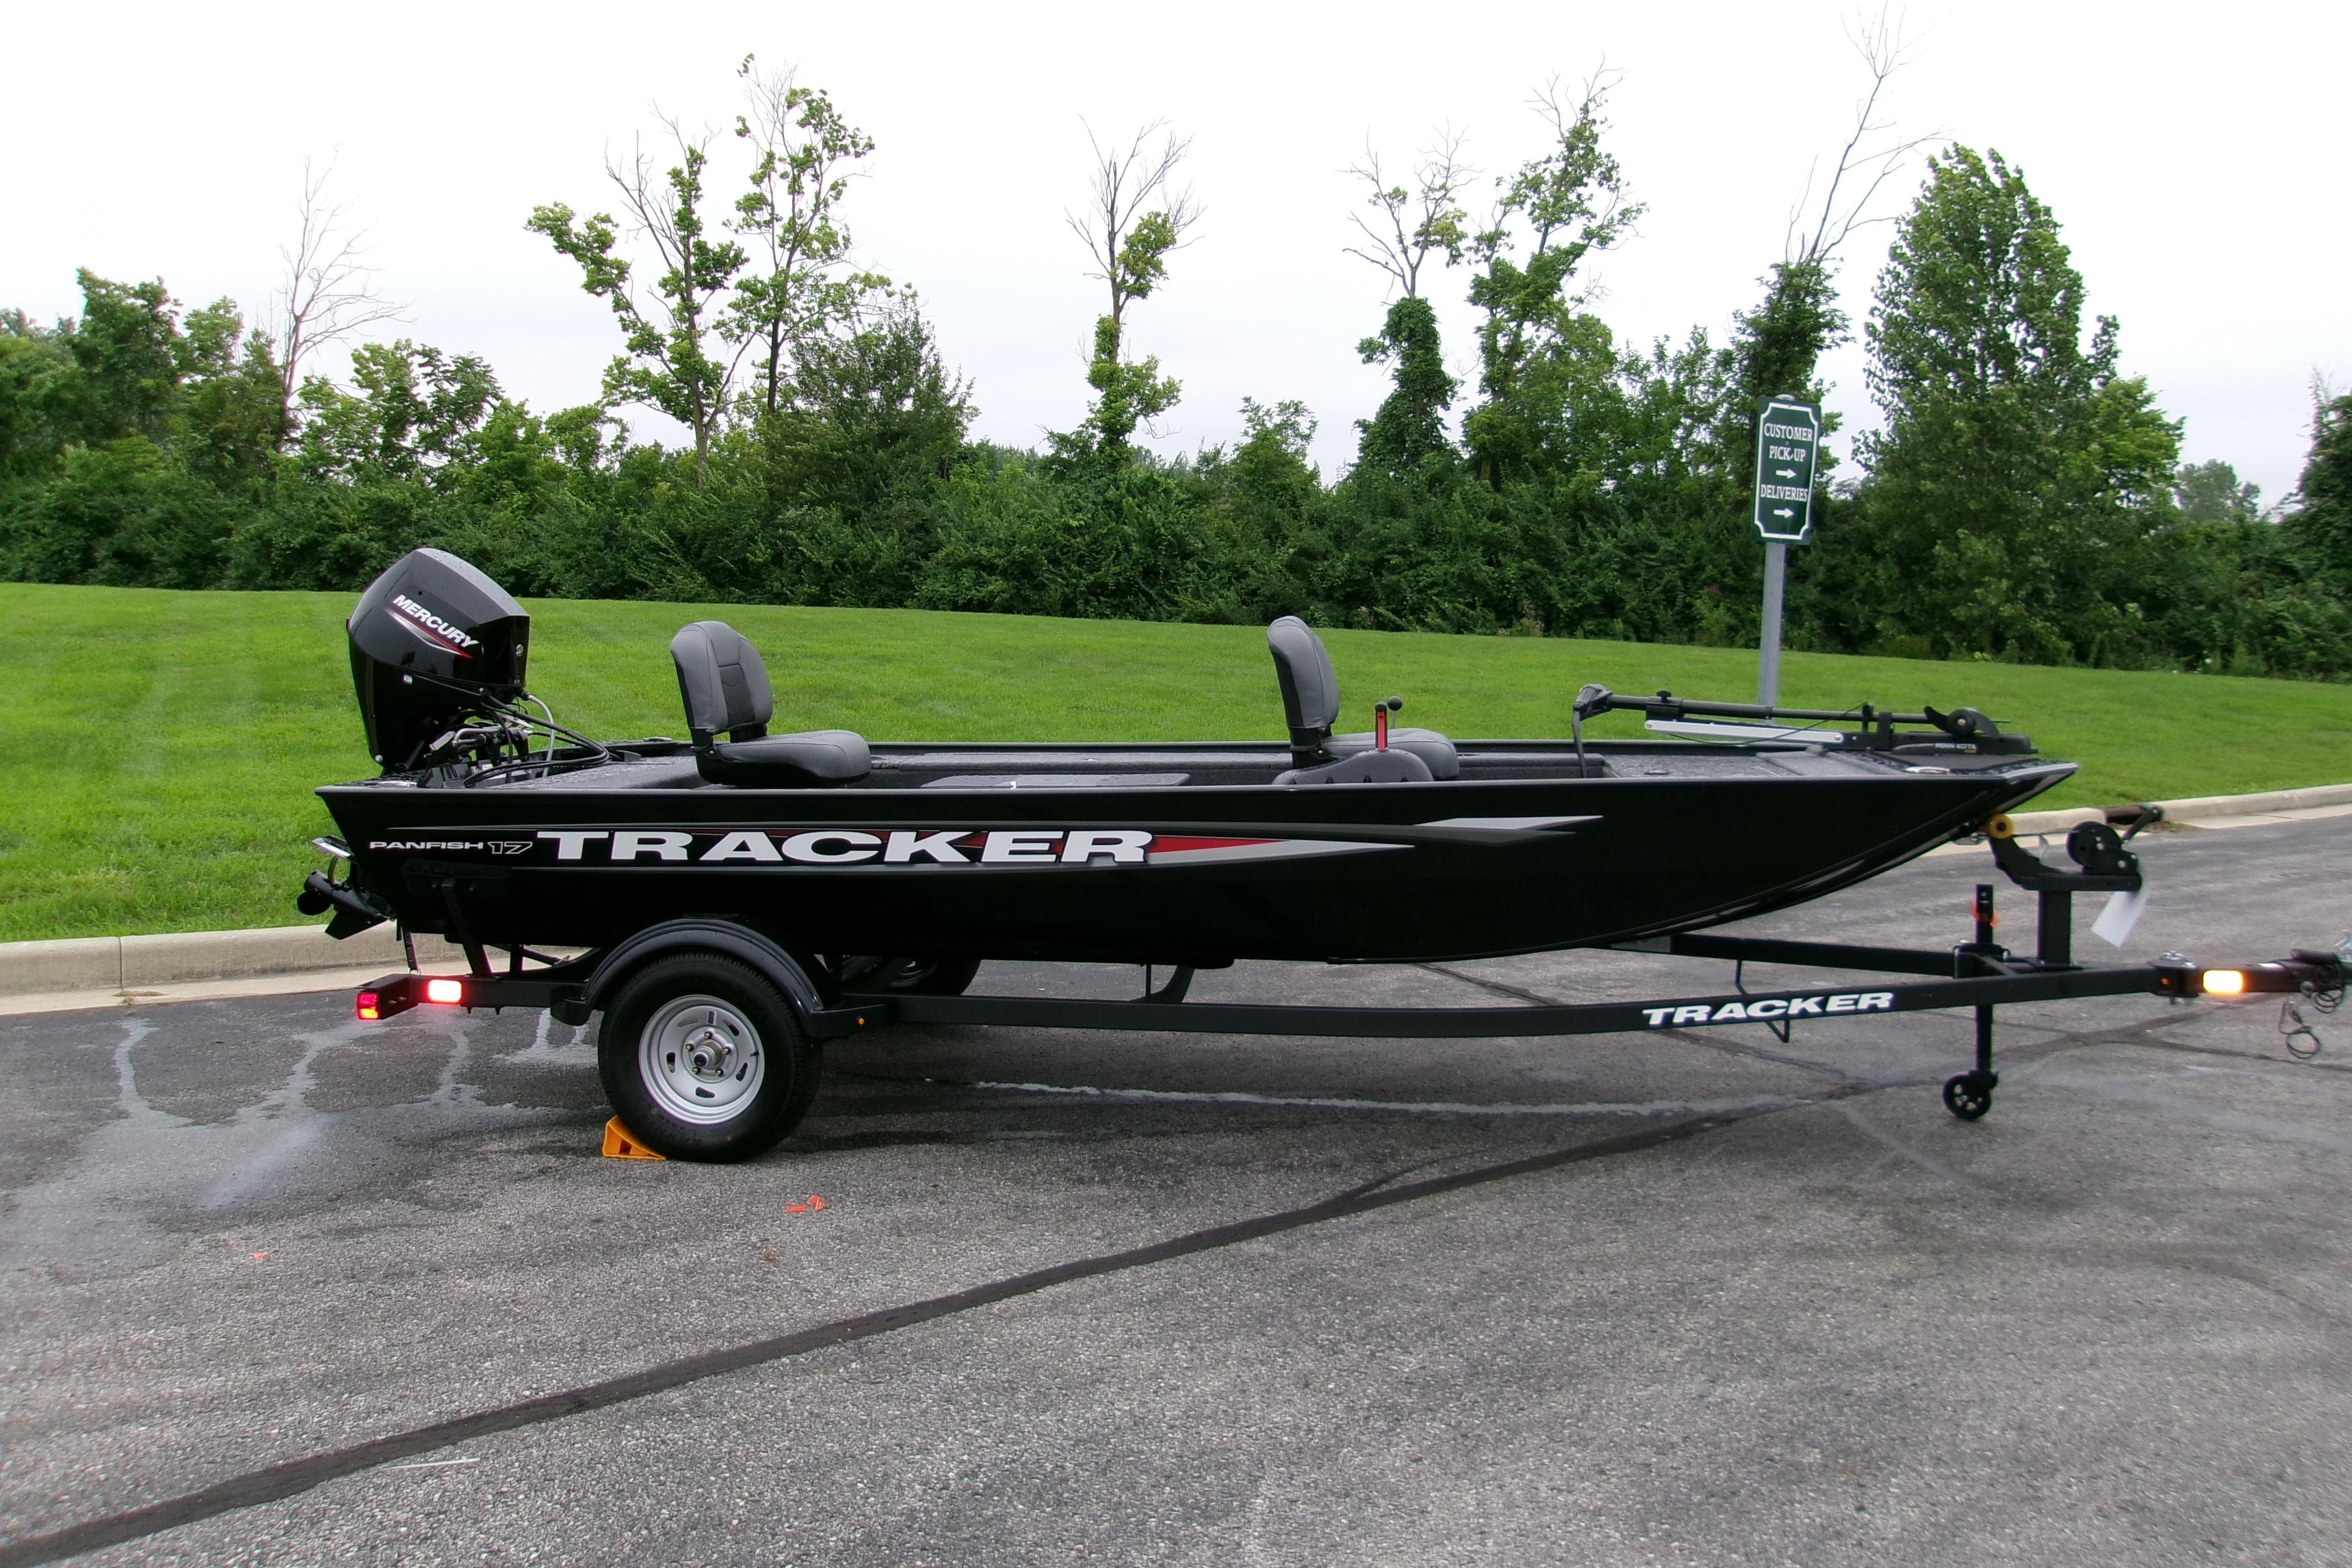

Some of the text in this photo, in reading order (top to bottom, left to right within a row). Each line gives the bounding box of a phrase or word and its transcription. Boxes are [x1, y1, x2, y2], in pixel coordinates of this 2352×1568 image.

[1764, 423, 1812, 442] CUSTOMER
[1760, 484, 1808, 502] DELIVERIES
[393, 594, 480, 648] MERCURY
[487, 842, 533, 854] 17
[536, 830, 1155, 863] TRACKER
[1642, 992, 1894, 1025] TRACKER
